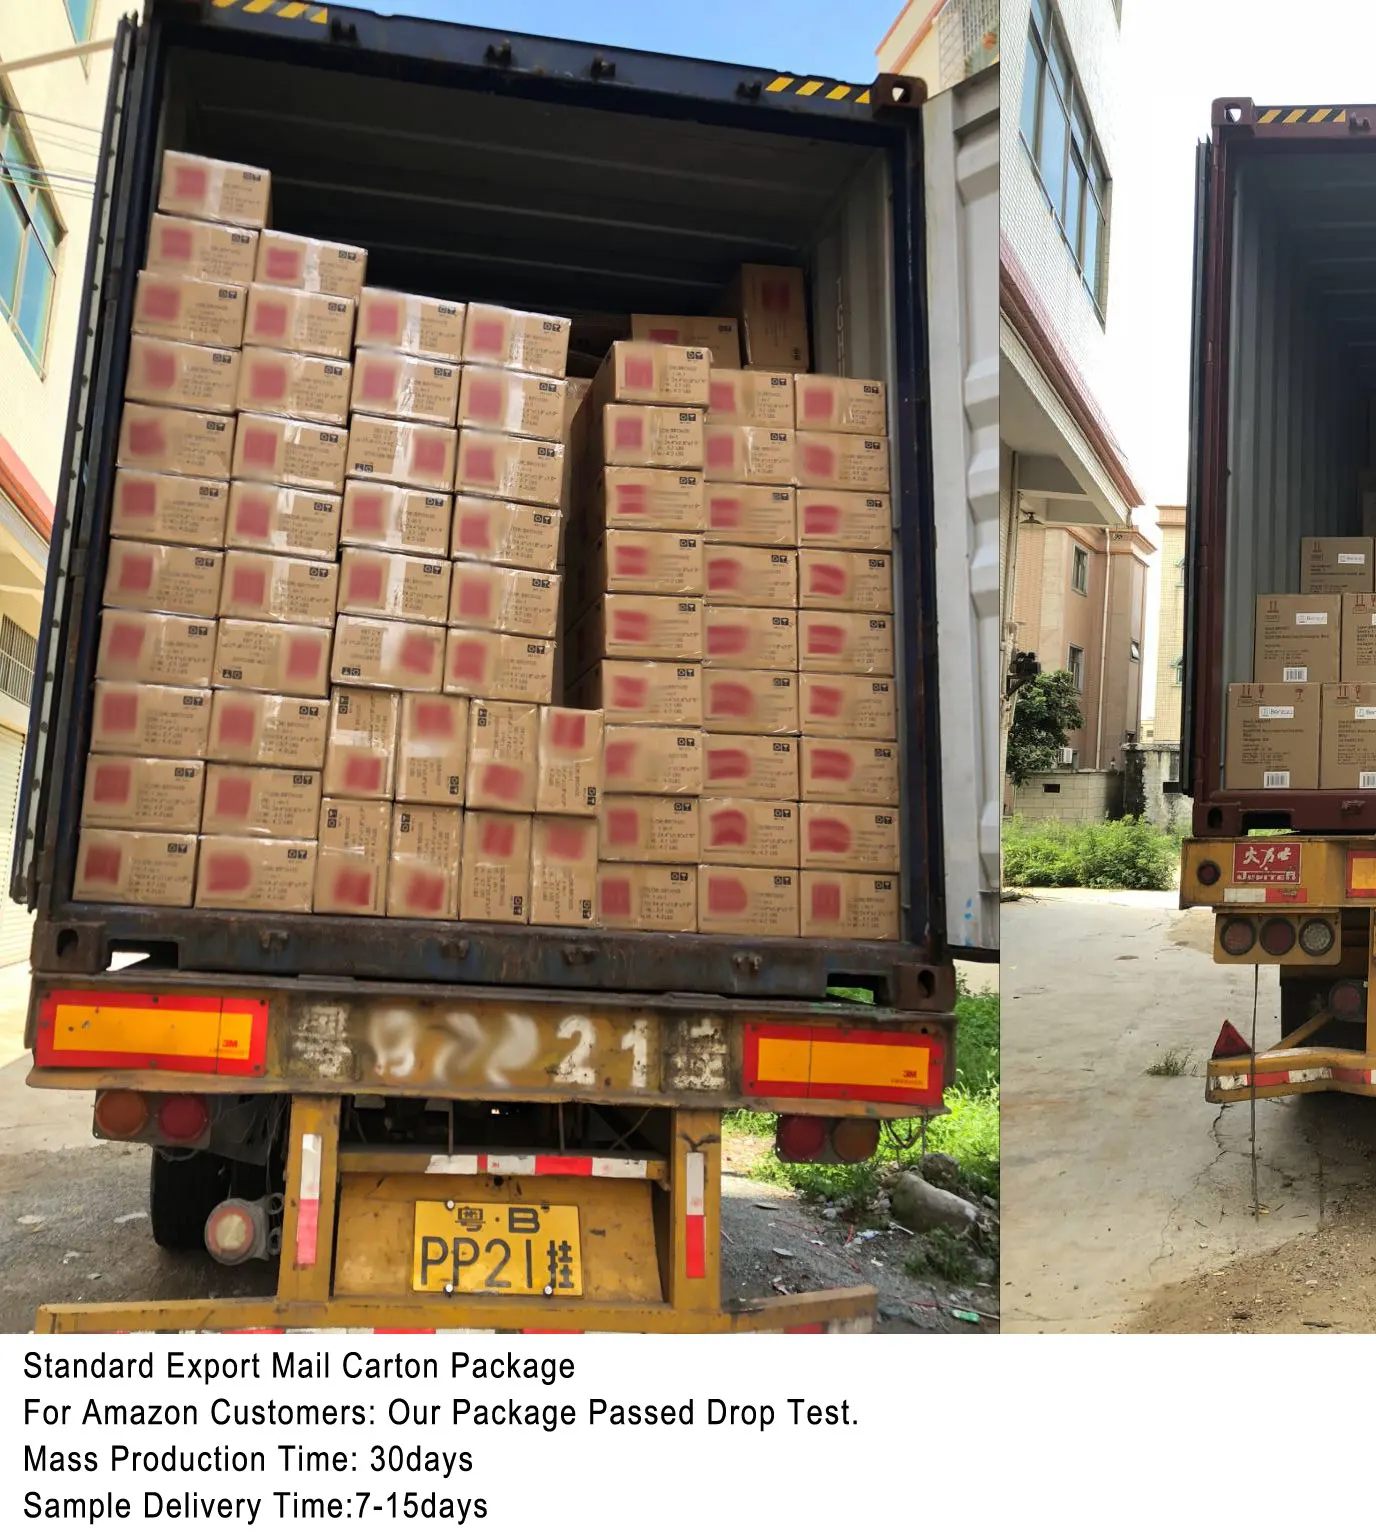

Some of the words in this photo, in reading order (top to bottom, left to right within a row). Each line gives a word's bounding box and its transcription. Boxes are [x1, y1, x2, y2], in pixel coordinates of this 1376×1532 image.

[222, 1039, 239, 1048] 3M
[903, 1070, 917, 1078] 3M
[420, 1236, 575, 1289] PP21挂
